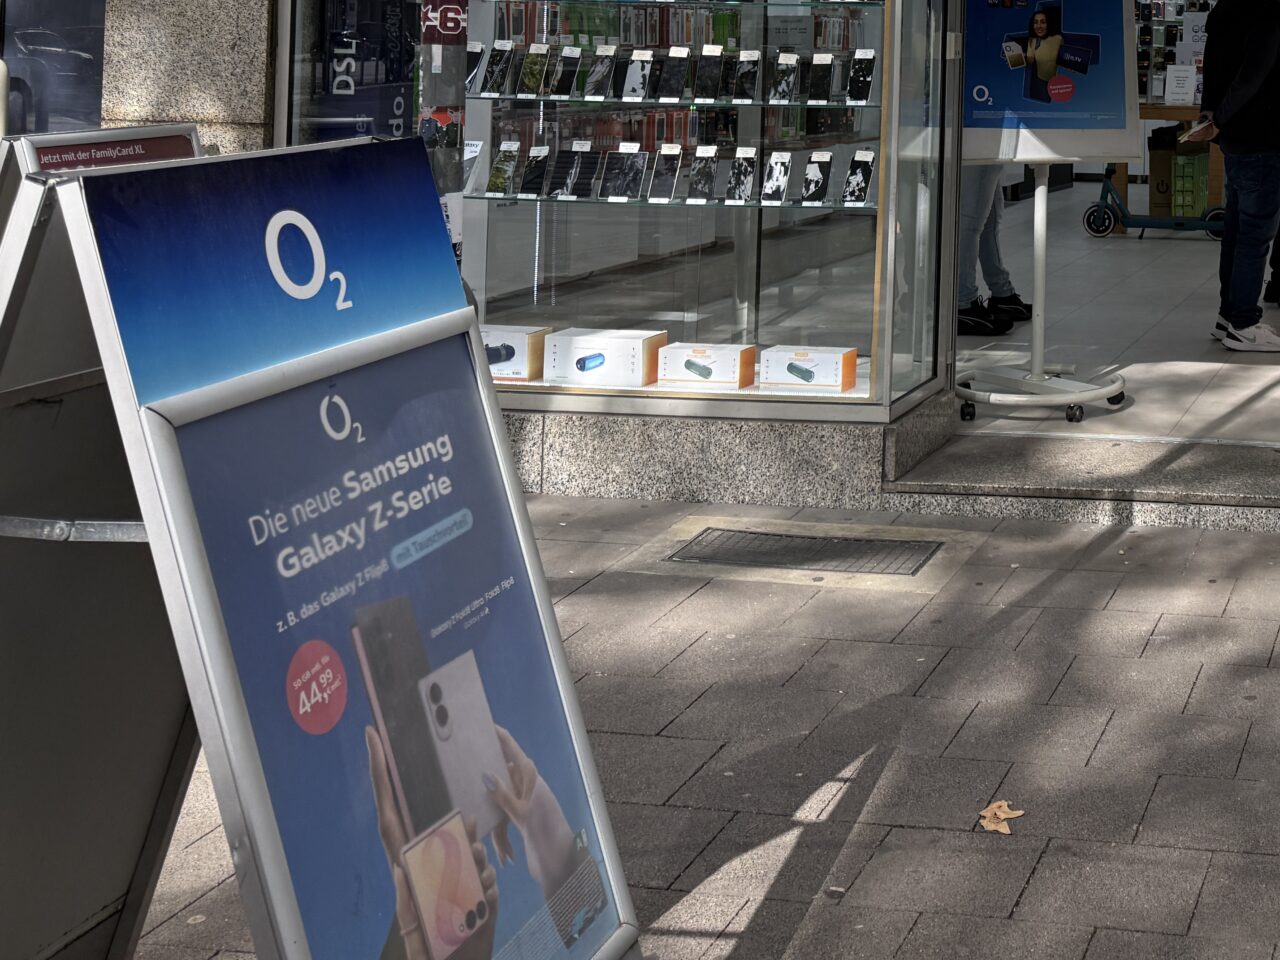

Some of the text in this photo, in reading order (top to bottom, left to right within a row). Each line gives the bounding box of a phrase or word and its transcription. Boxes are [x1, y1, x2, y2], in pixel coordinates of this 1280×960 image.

[972, 84, 993, 106] O2
[40, 144, 145, 165] Jetzt mit der FamilyCard XL
[248, 432, 454, 546] Die neue Samsung
[276, 473, 453, 578] Galaxy Z-Serie
[299, 599, 320, 621] das
[319, 580, 358, 613] Galaxy
